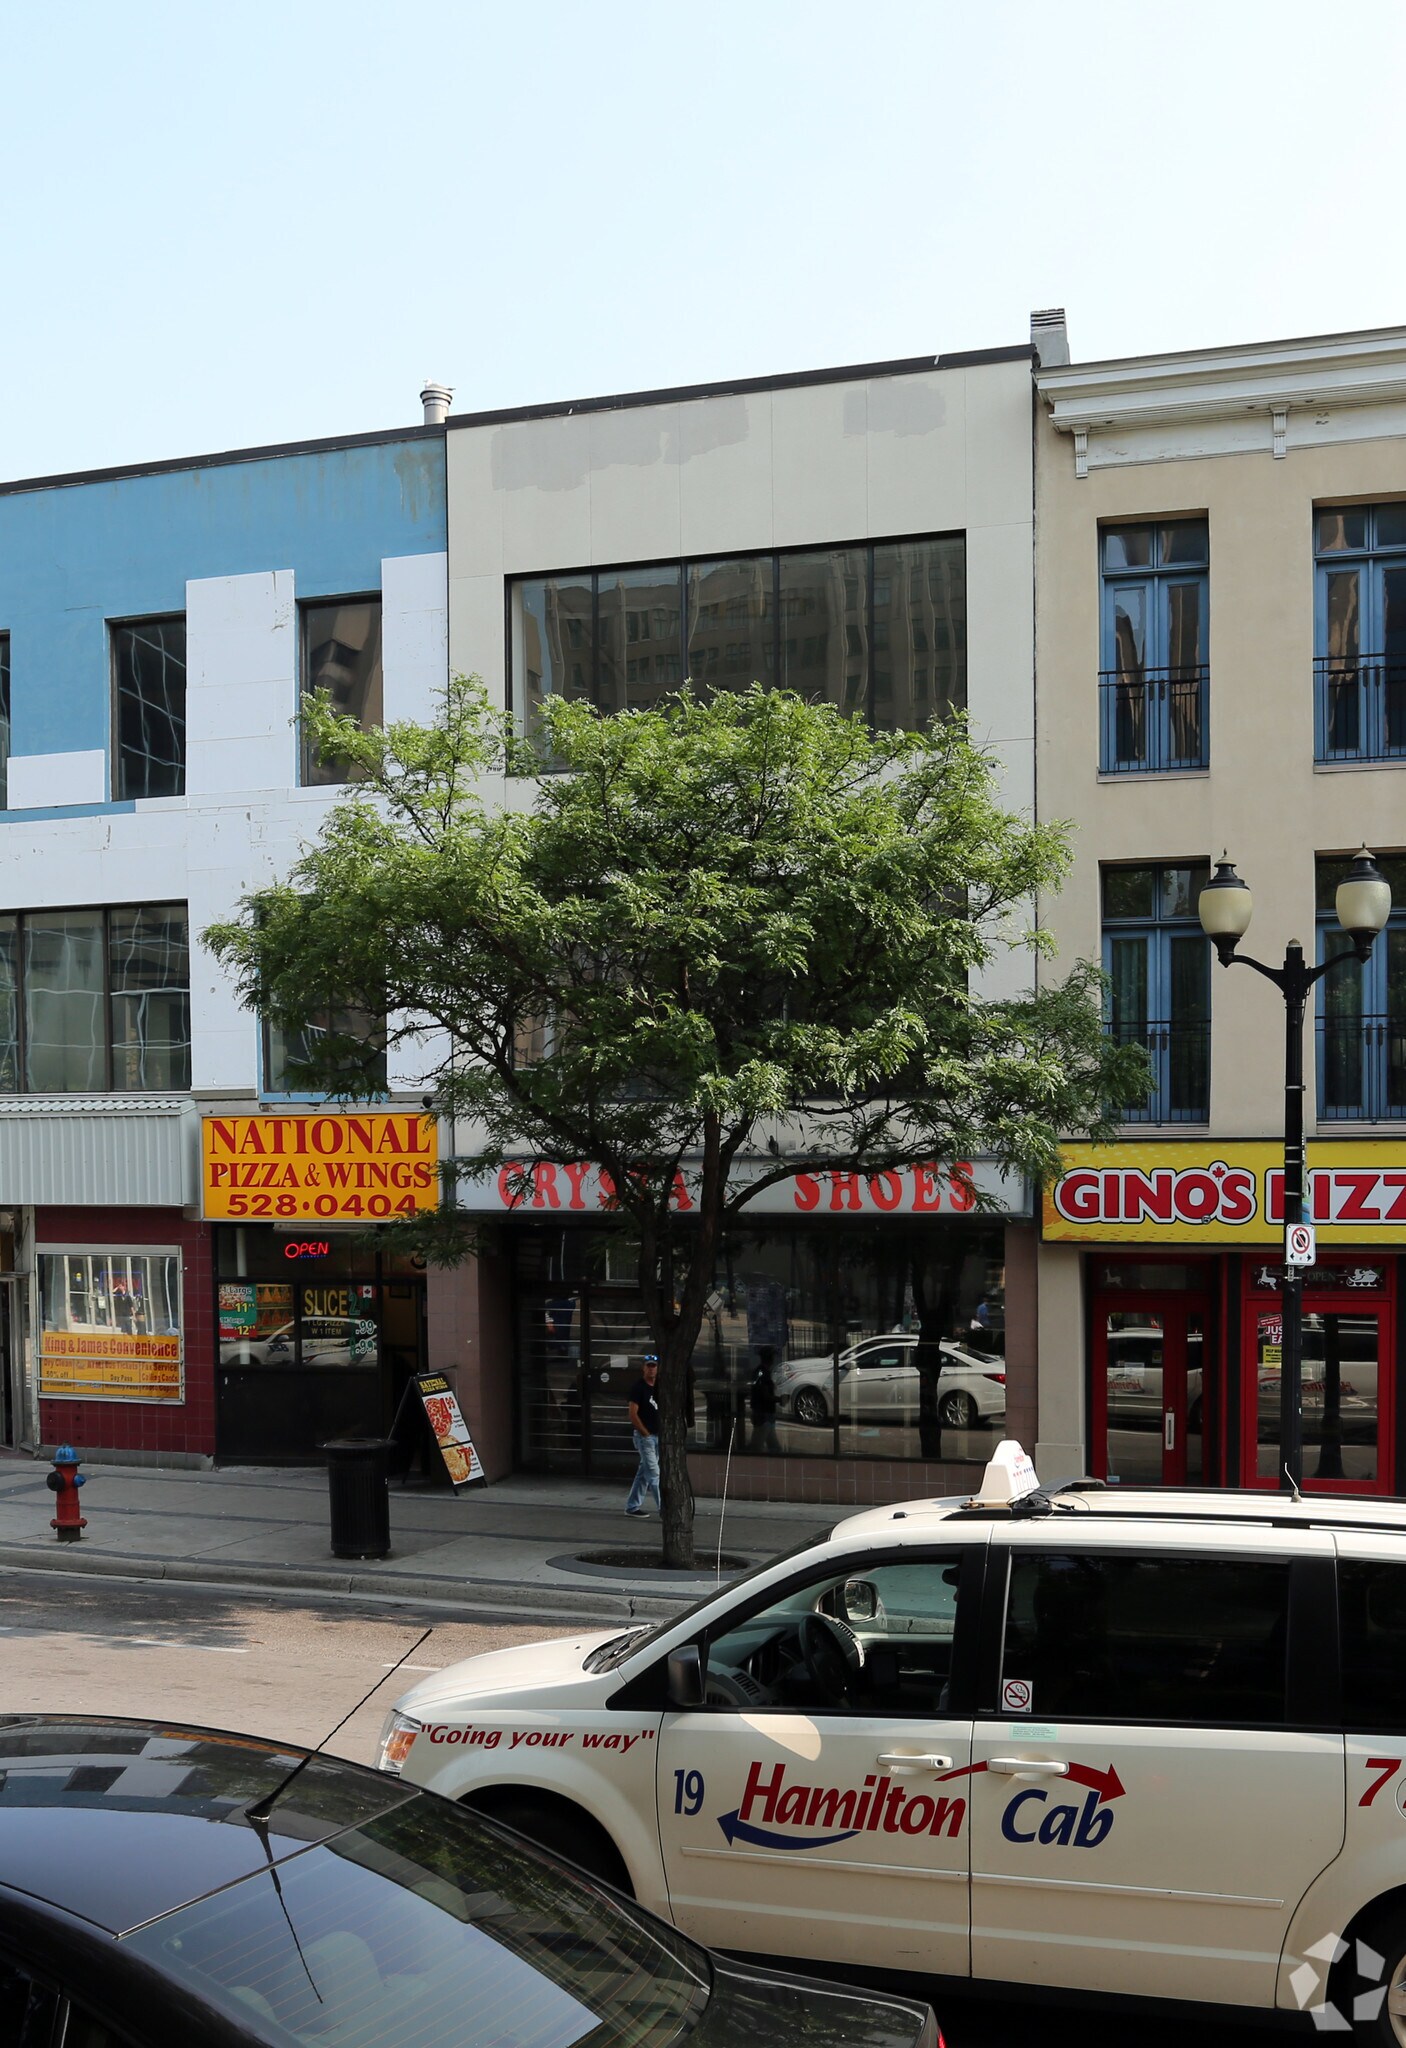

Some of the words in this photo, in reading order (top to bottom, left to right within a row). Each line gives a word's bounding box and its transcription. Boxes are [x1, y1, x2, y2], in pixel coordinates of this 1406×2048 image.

[209, 1117, 431, 1155] NATIONAL
[209, 1162, 300, 1188] PIZZA
[303, 1162, 320, 1187] &
[323, 1161, 432, 1189] WINGS
[498, 1161, 727, 1211] CRYSA
[794, 1160, 976, 1212] SHOES
[1059, 1169, 1252, 1220] GINO'S
[284, 1242, 330, 1259] OPEN
[304, 1289, 348, 1316] SLICE
[1265, 1325, 1283, 1335] JUS
[1271, 1335, 1283, 1344] EA
[45, 1336, 66, 1354] King
[68, 1339, 75, 1352] &
[76, 1337, 108, 1354] James
[109, 1338, 178, 1357] Convenience
[153, 1362, 177, 1372] Service
[420, 1724, 502, 1749] "Going
[507, 1730, 574, 1750] your
[582, 1729, 655, 1754] way"
[673, 1769, 705, 1816] 19
[738, 1761, 966, 1838] Hamilton
[1000, 1788, 1114, 1849] Cab
